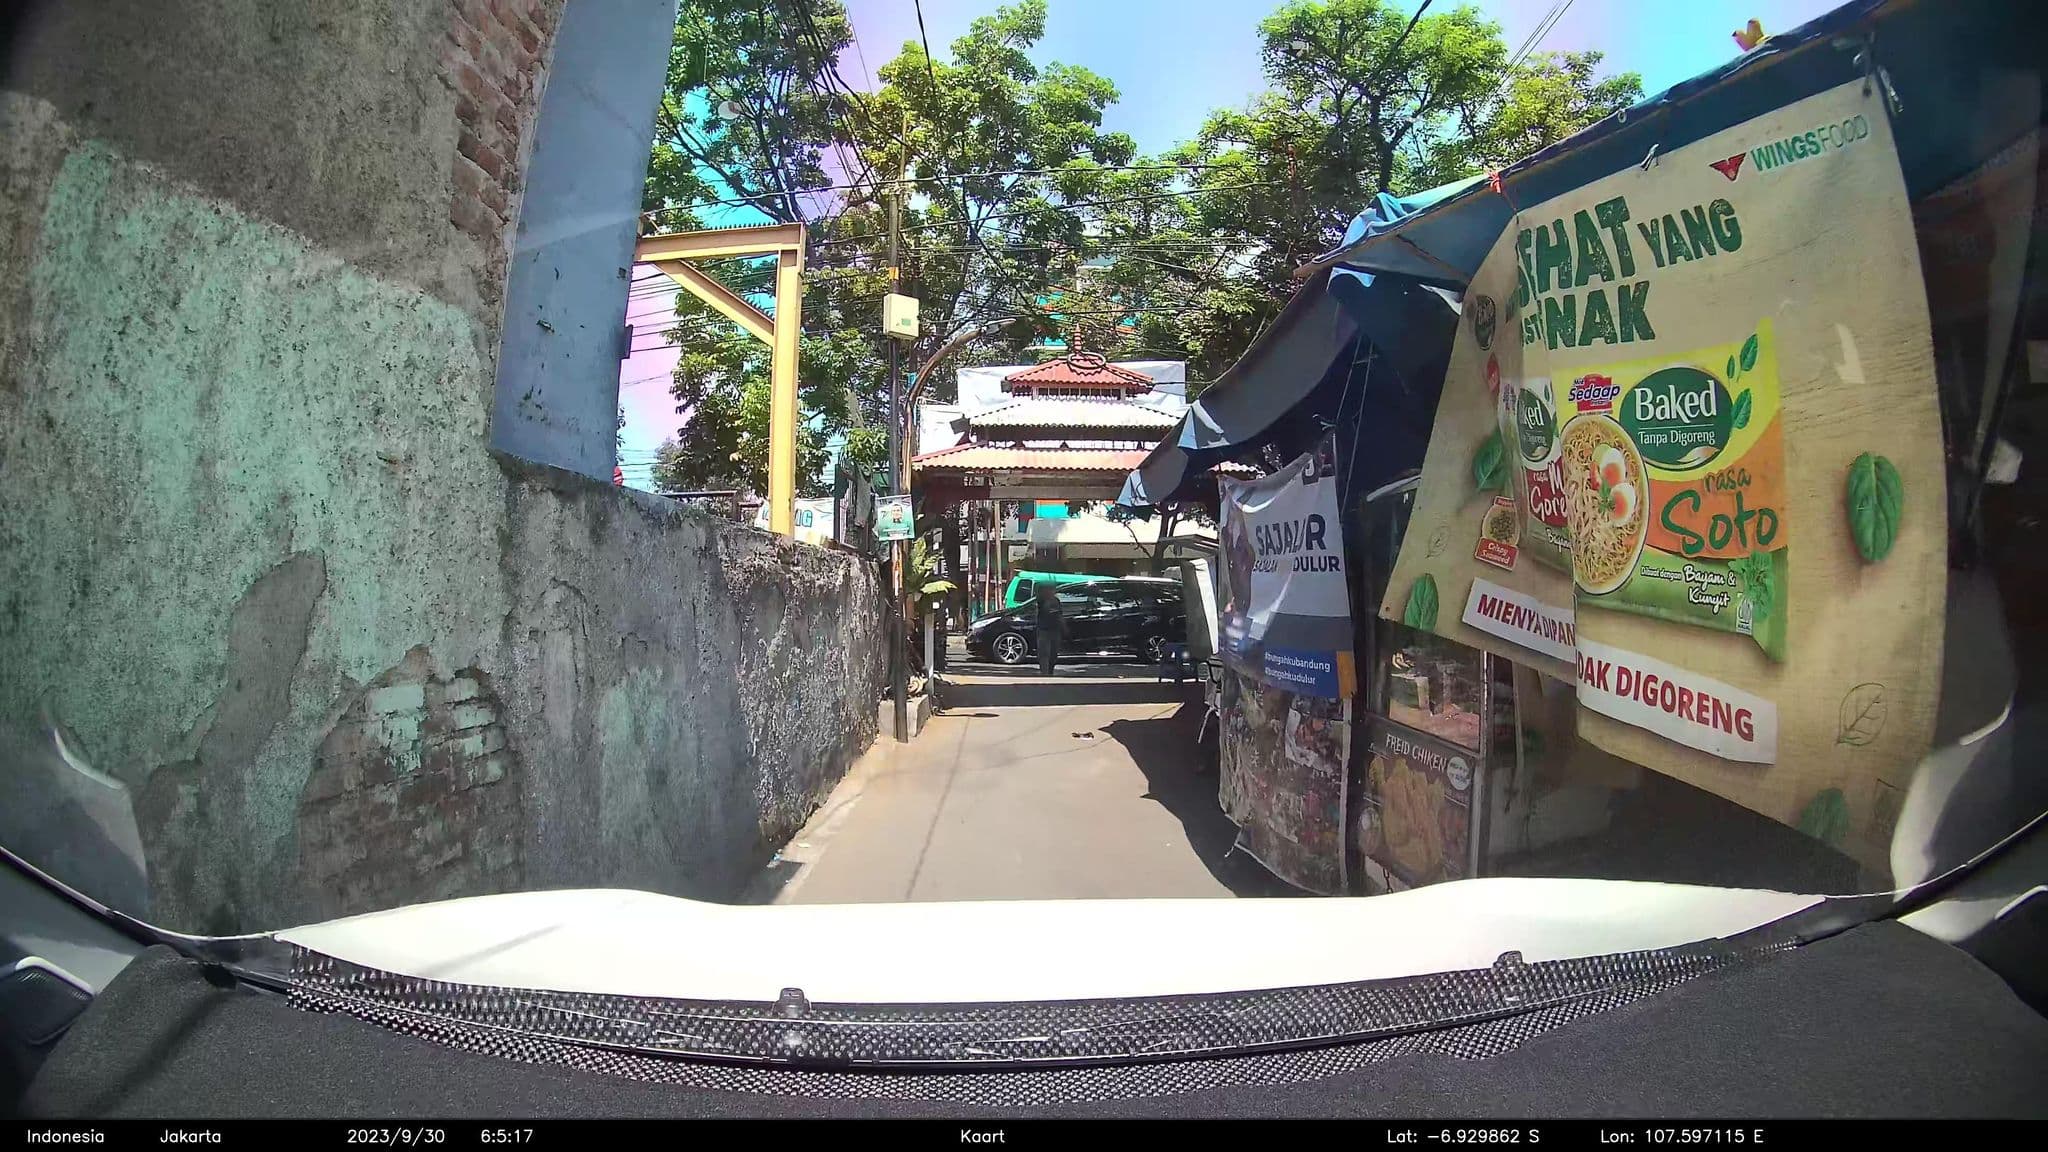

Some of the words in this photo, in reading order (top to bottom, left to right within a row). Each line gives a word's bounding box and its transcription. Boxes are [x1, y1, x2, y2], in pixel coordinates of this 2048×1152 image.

[1637, 198, 1743, 268] YANG
[1568, 384, 1621, 401] Sedaap
[1634, 379, 1717, 424] Baked
[1638, 431, 1668, 447] Tanpa
[1670, 430, 1716, 447] Digoreng
[1704, 467, 1751, 492] rasa
[1661, 489, 1778, 555] Soto
[1293, 555, 1341, 572] DULUR
[1683, 564, 1725, 591] Bayam
[1727, 572, 1737, 587] &
[1688, 587, 1730, 614] Kunyit
[1616, 666, 1754, 742] DIGORENG
[1385, 733, 1410, 755] FREID
[1411, 745, 1448, 773] CHIKEN
